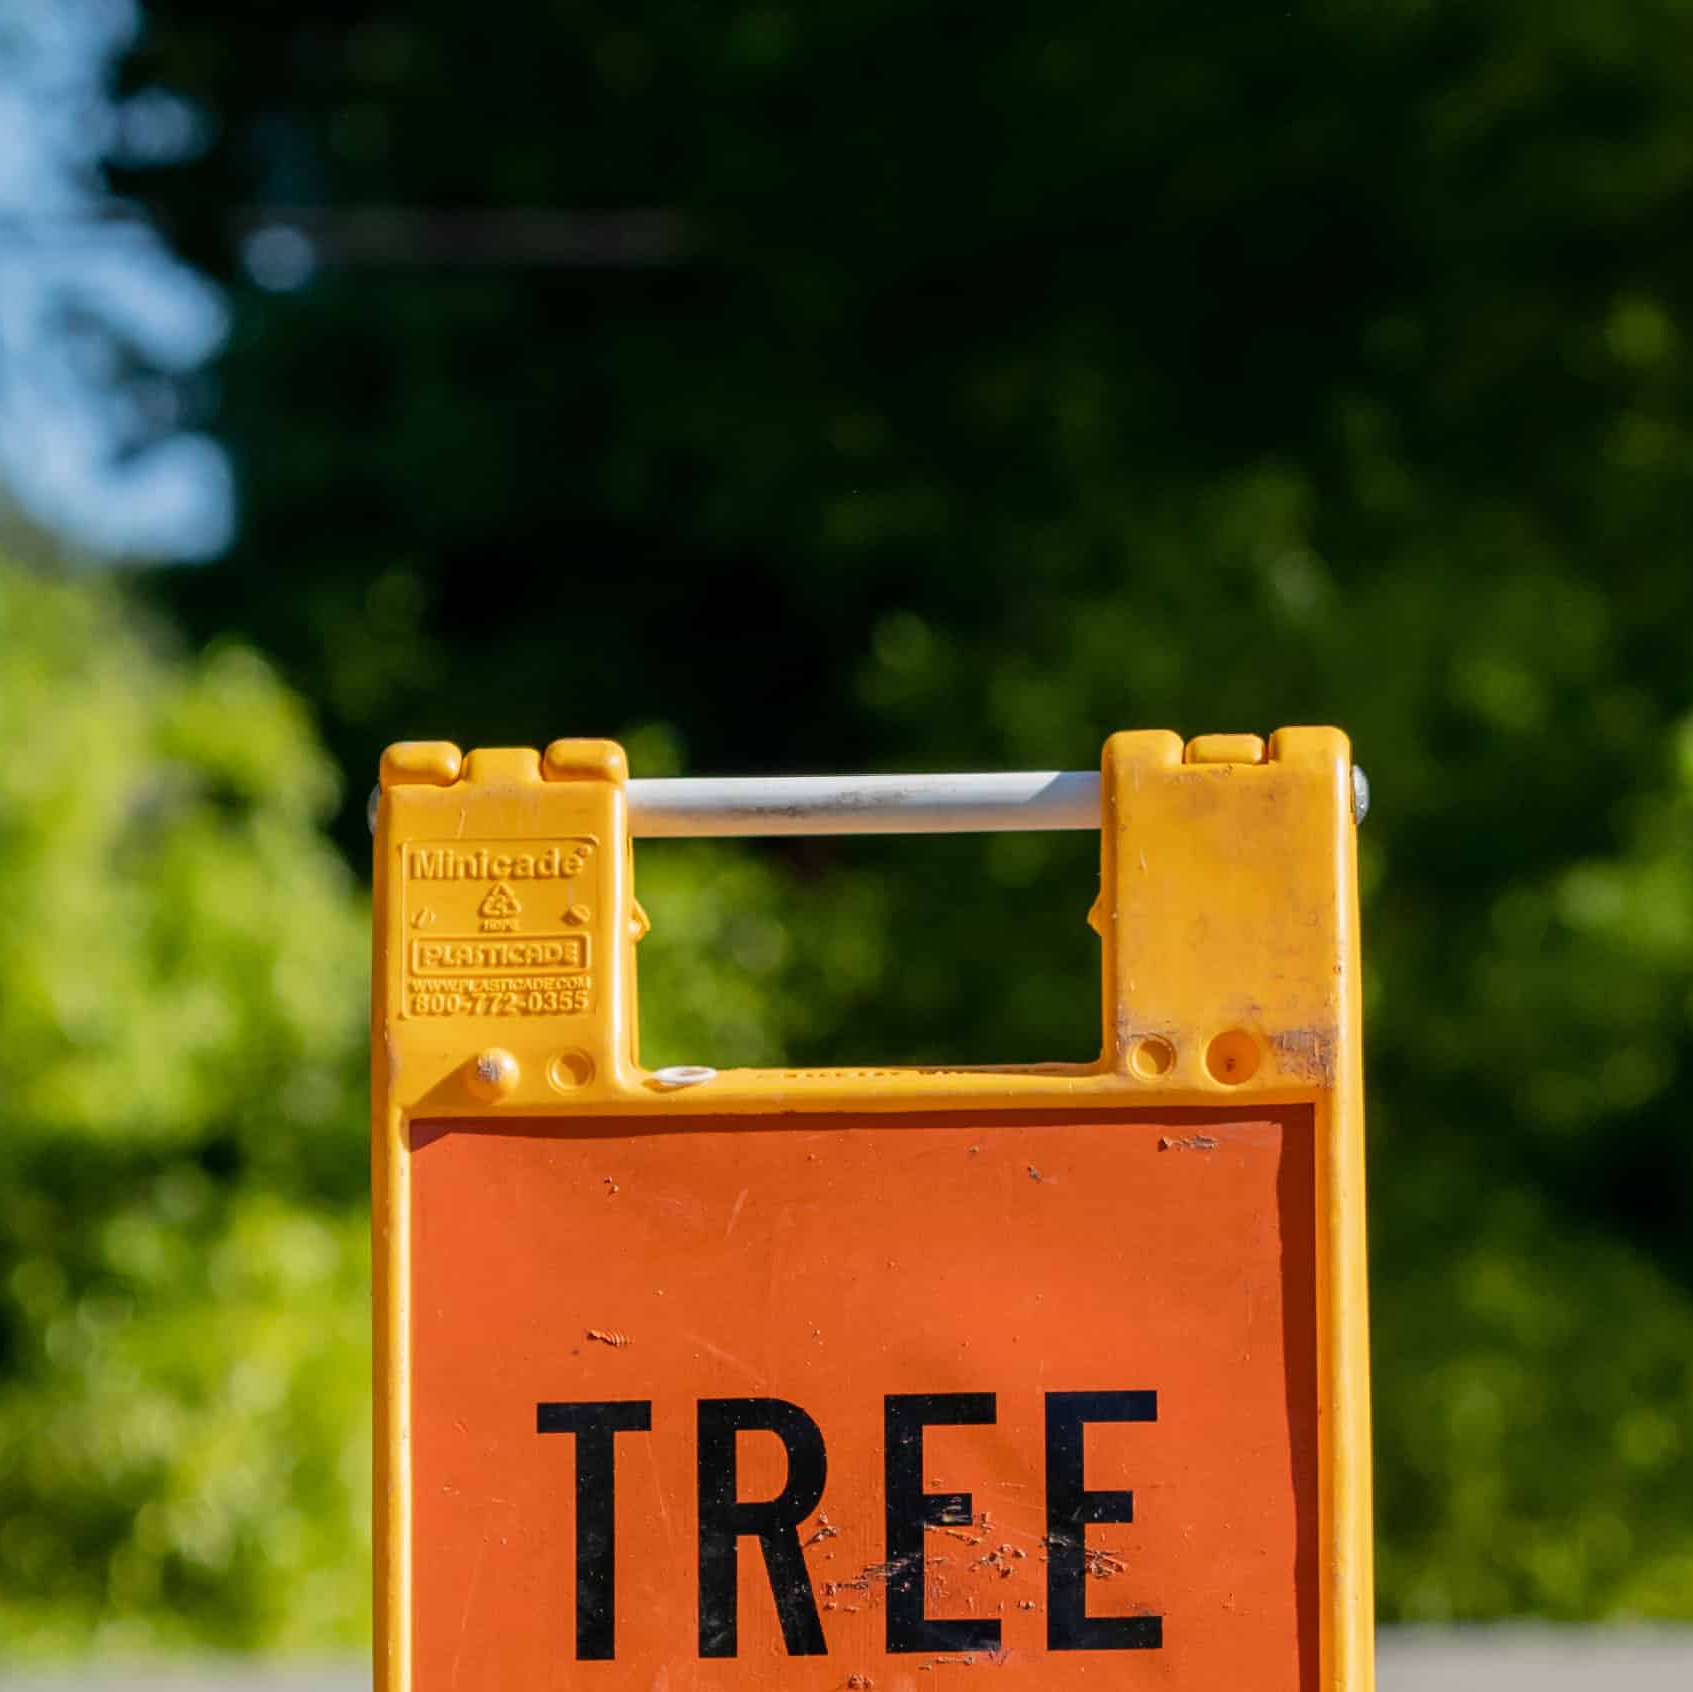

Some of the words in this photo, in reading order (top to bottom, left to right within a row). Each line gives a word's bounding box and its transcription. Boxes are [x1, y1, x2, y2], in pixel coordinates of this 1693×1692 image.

[422, 942, 580, 968] PLASTICADE
[413, 991, 590, 1014] 800-772-0355
[536, 1389, 1164, 1661] TREE
